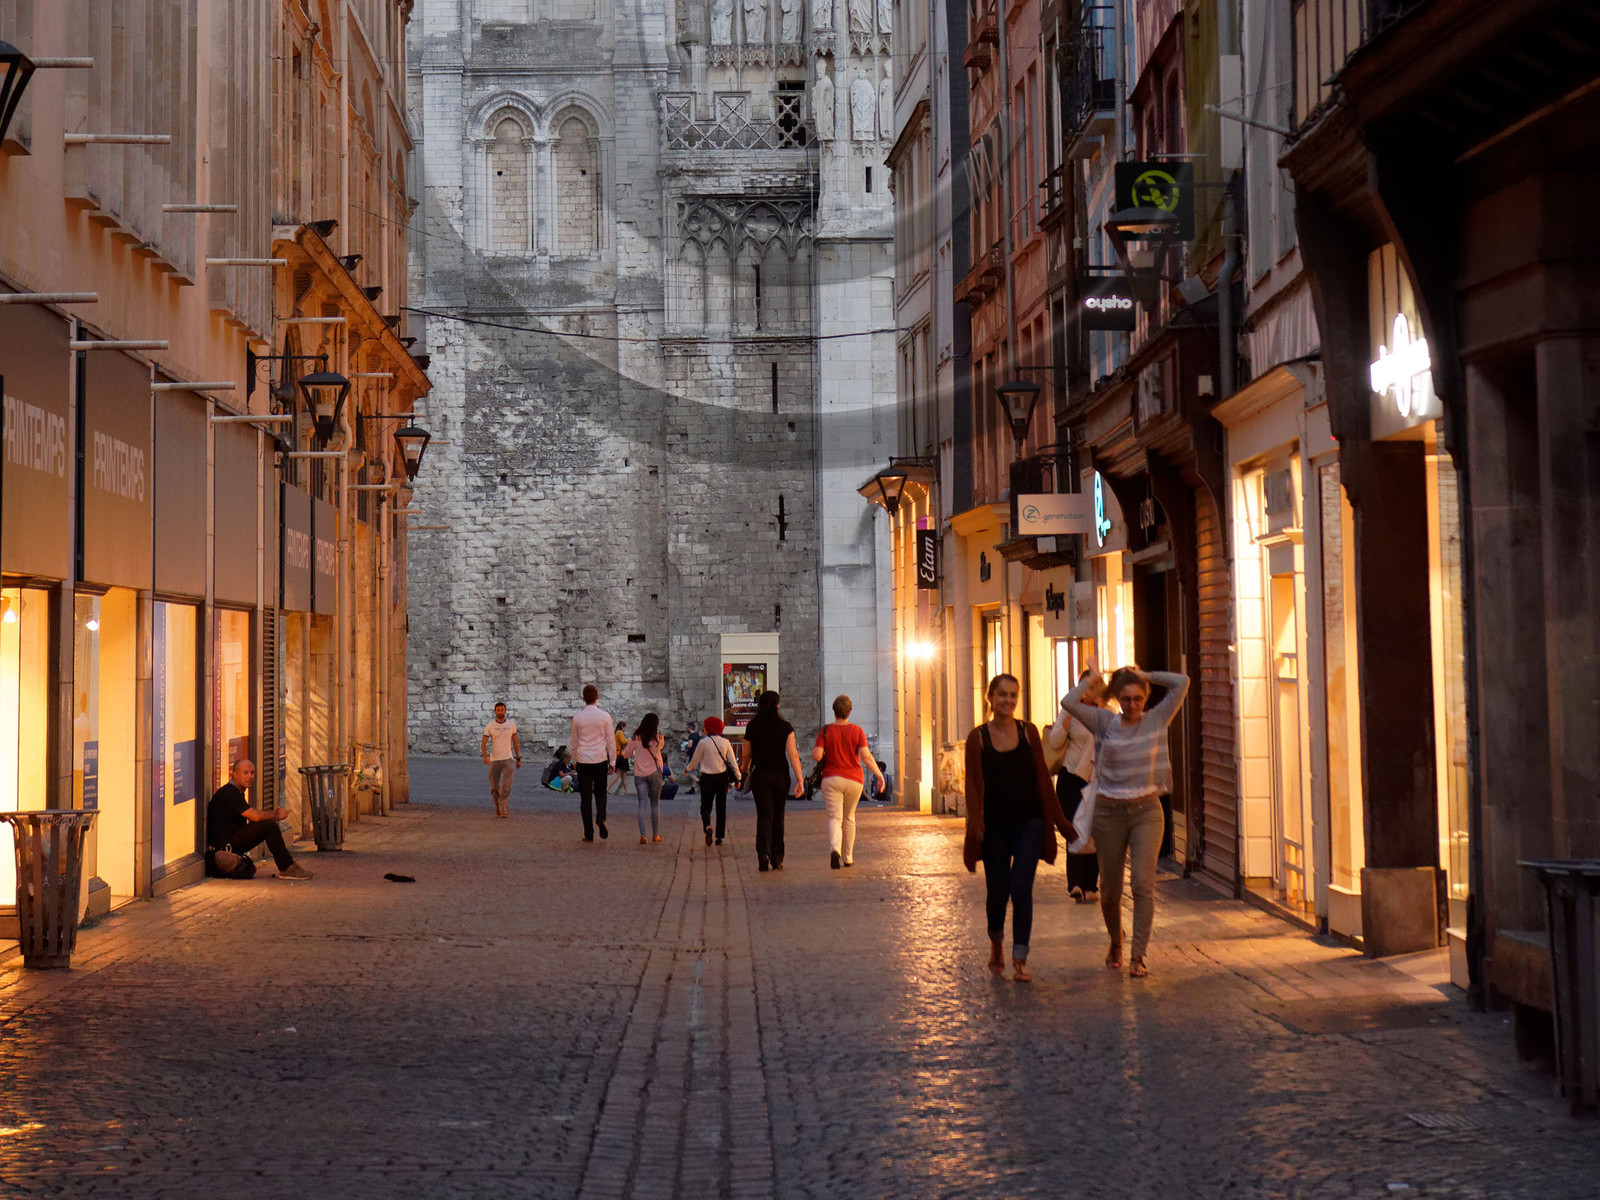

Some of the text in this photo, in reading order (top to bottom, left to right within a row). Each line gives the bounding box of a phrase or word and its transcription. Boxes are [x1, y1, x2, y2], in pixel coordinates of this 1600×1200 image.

[1085, 294, 1133, 312] oysho
[93, 430, 145, 503] PRINTEMPS
[920, 536, 935, 583] Etam
